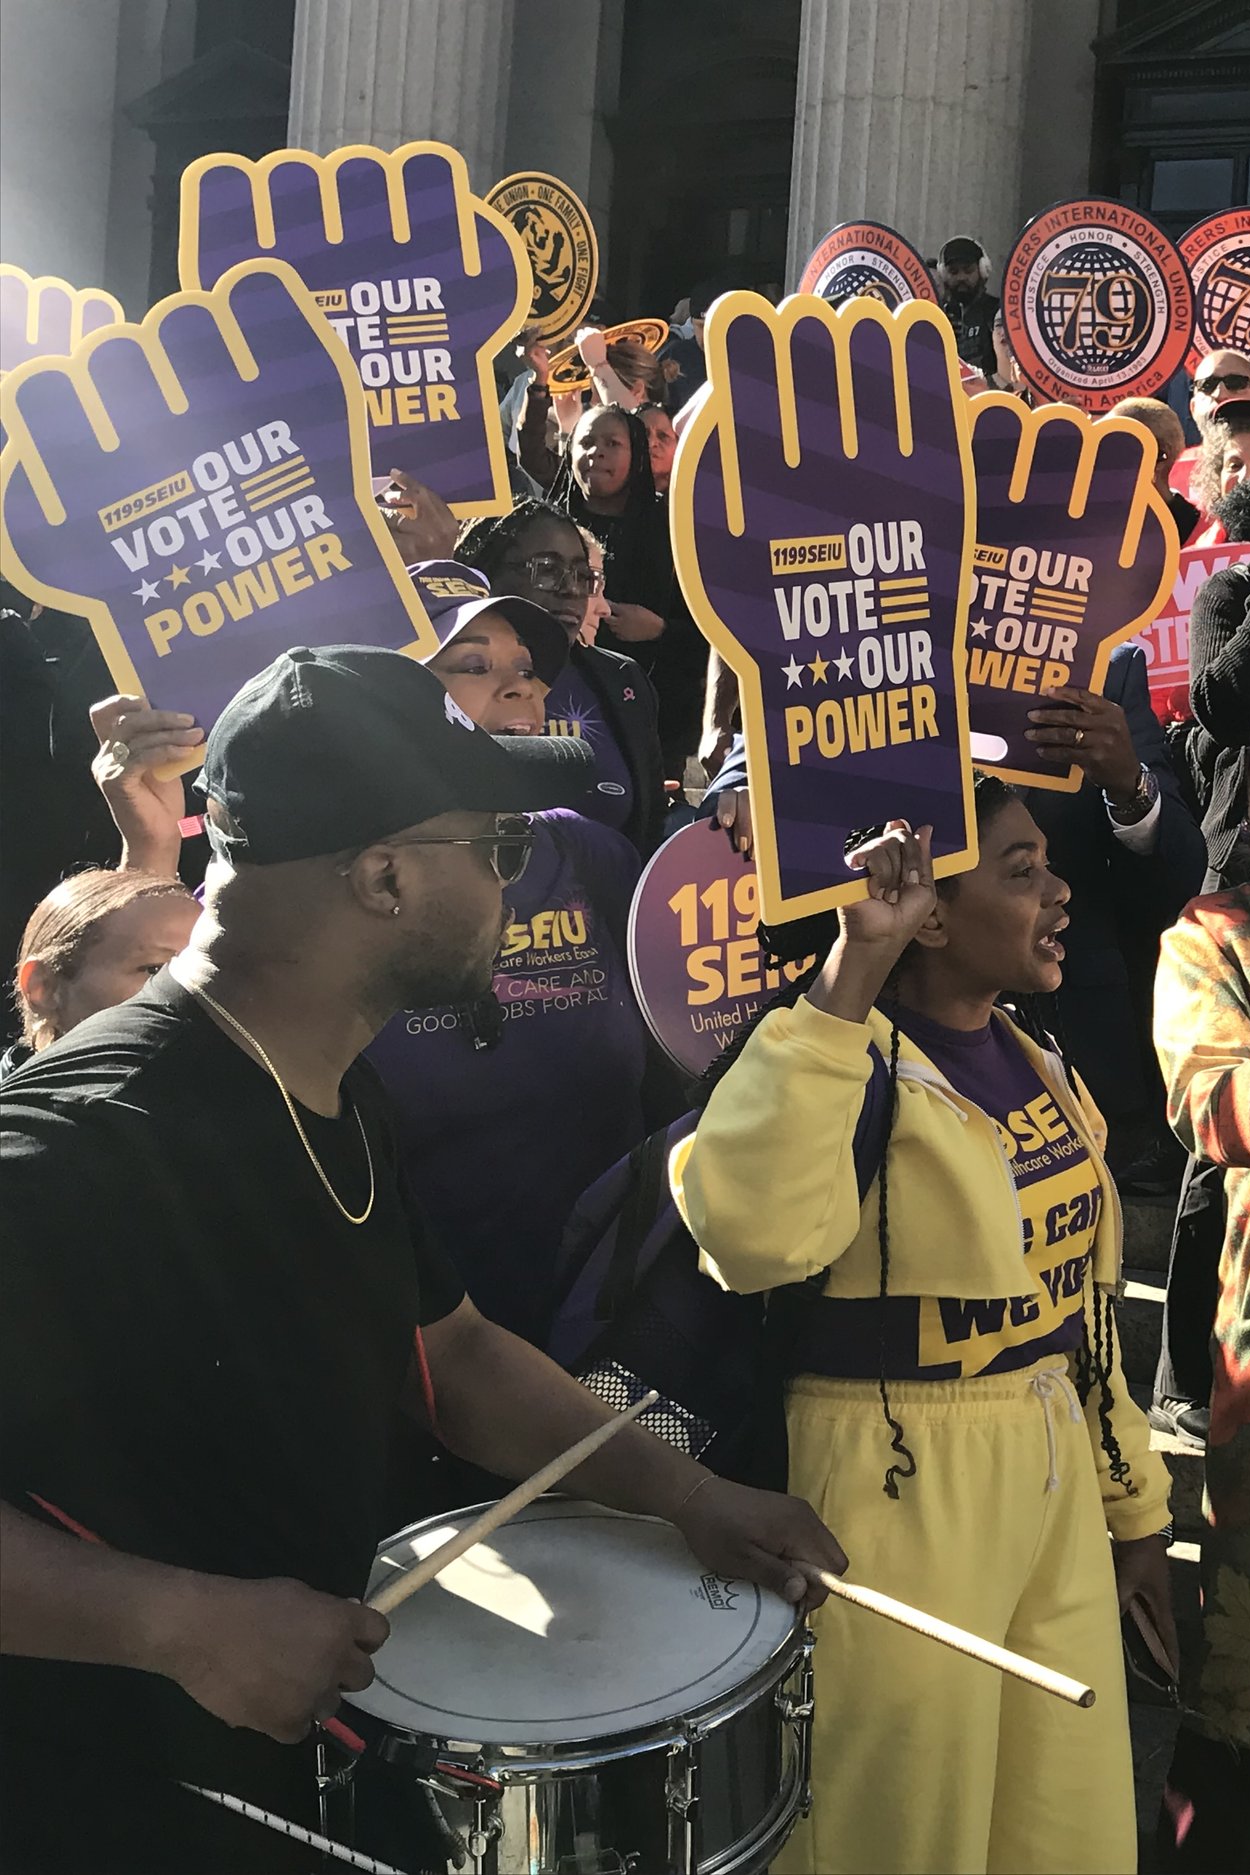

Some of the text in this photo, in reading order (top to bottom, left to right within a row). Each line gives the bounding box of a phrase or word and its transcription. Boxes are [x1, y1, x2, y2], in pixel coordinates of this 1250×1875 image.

[537, 185, 554, 203] ONE
[553, 194, 581, 230] FAMILY
[576, 240, 589, 264] ONE
[1185, 221, 1228, 262] RERS'
[1193, 244, 1229, 282] USTICE
[573, 266, 590, 300] FIGHT
[810, 230, 931, 300] INTERNATIONAL UNIO
[825, 255, 854, 281] HONOR
[1009, 206, 1189, 332] LABORERS' INTERNATIONAL UNION
[1027, 231, 1165, 314] JUSTICE HONOR STRENGTH
[351, 277, 445, 316] OUR
[1041, 269, 1151, 352] 79
[327, 315, 384, 350] TE
[360, 348, 456, 387] OUR
[1035, 369, 1050, 385] of
[1048, 357, 1088, 385] Organized
[1090, 377, 1113, 386] April
[103, 420, 300, 527] 1199SEIU OUR
[110, 485, 246, 572] VOTE
[225, 494, 334, 567] OUR
[773, 520, 926, 576] 1199SEIU OUR
[1009, 546, 1093, 592] OUR
[144, 533, 353, 657] POWER
[774, 579, 878, 641] VOTE
[969, 573, 1030, 616] TE
[858, 630, 935, 689] OUR
[994, 617, 1079, 663] OUR
[968, 648, 1071, 696] WER
[785, 684, 940, 766] POWER
[668, 873, 758, 946] 119
[526, 951, 572, 966] Workers
[508, 976, 561, 997] CARE
[570, 969, 605, 988] AND
[406, 1013, 460, 1035] GOO
[501, 1001, 535, 1022] OBS
[543, 992, 582, 1014] FOR
[691, 1003, 743, 1033] United
[705, 1577, 724, 1607] REMO
